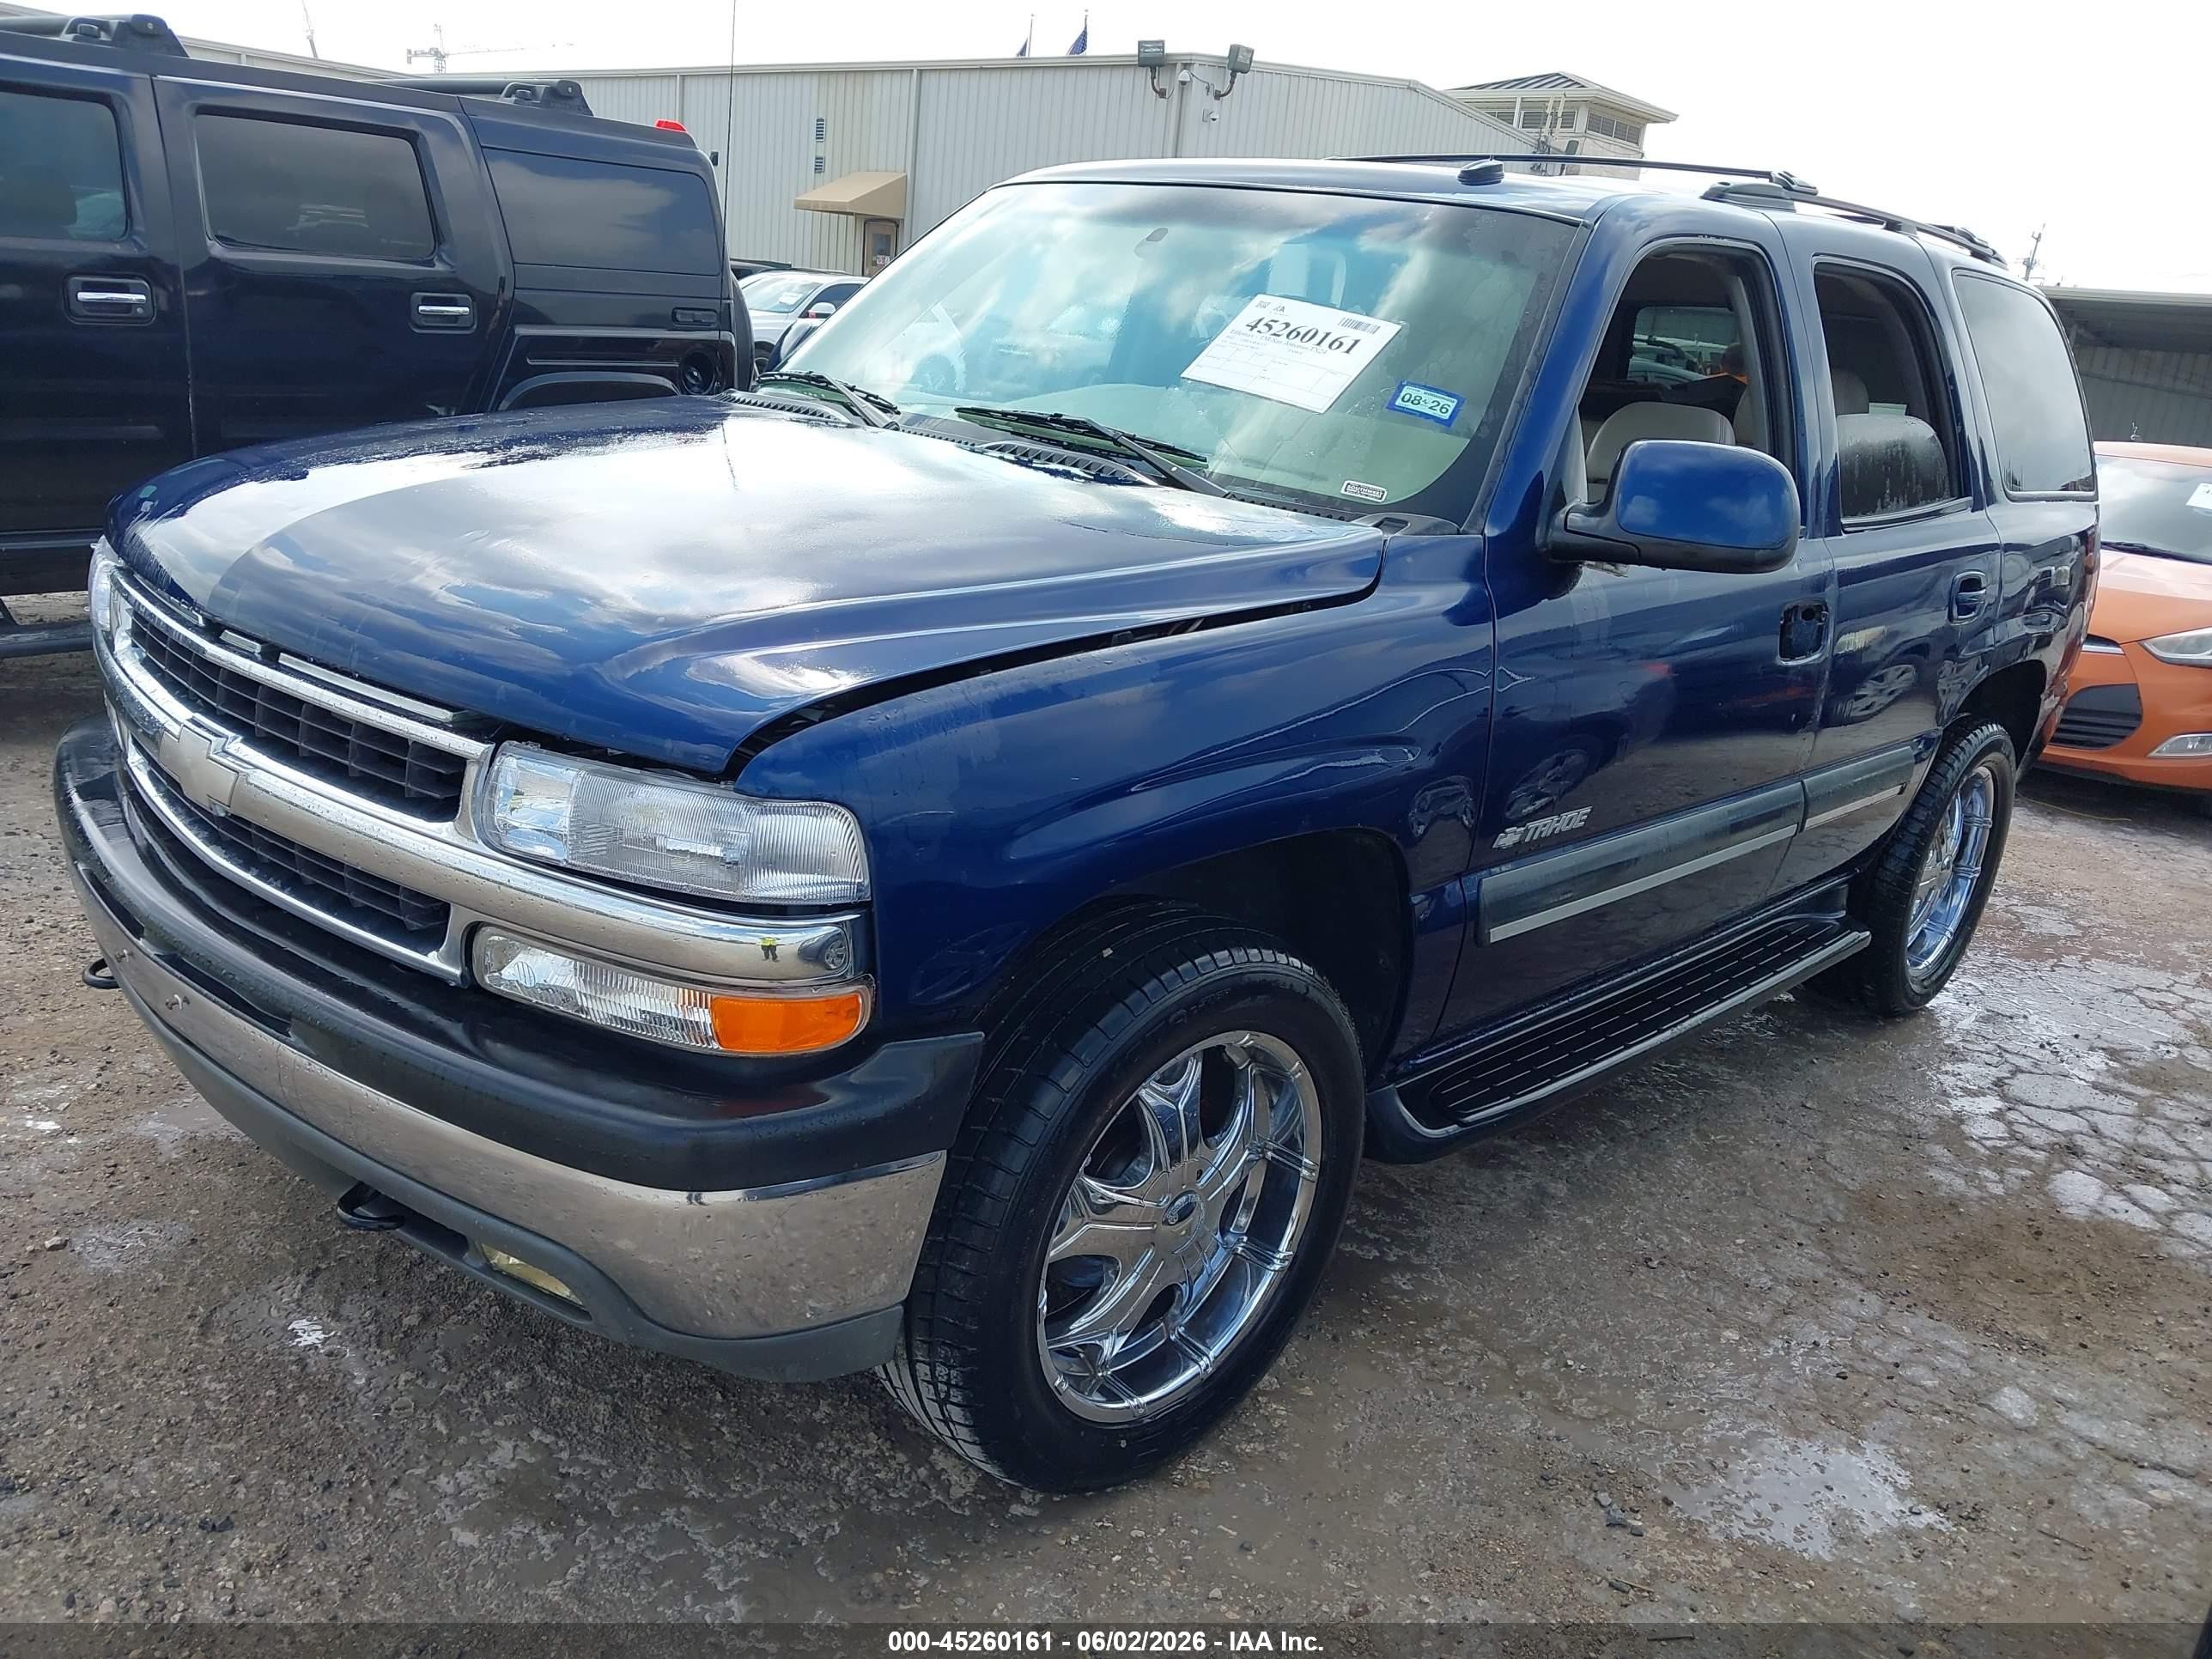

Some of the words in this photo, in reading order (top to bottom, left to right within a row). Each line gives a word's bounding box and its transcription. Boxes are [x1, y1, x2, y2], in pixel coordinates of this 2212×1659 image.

[1245, 317, 1361, 355] 45260161
[1401, 392, 1423, 406] 08
[1428, 399, 1451, 415] 26
[1524, 805, 1593, 842] TAHOE
